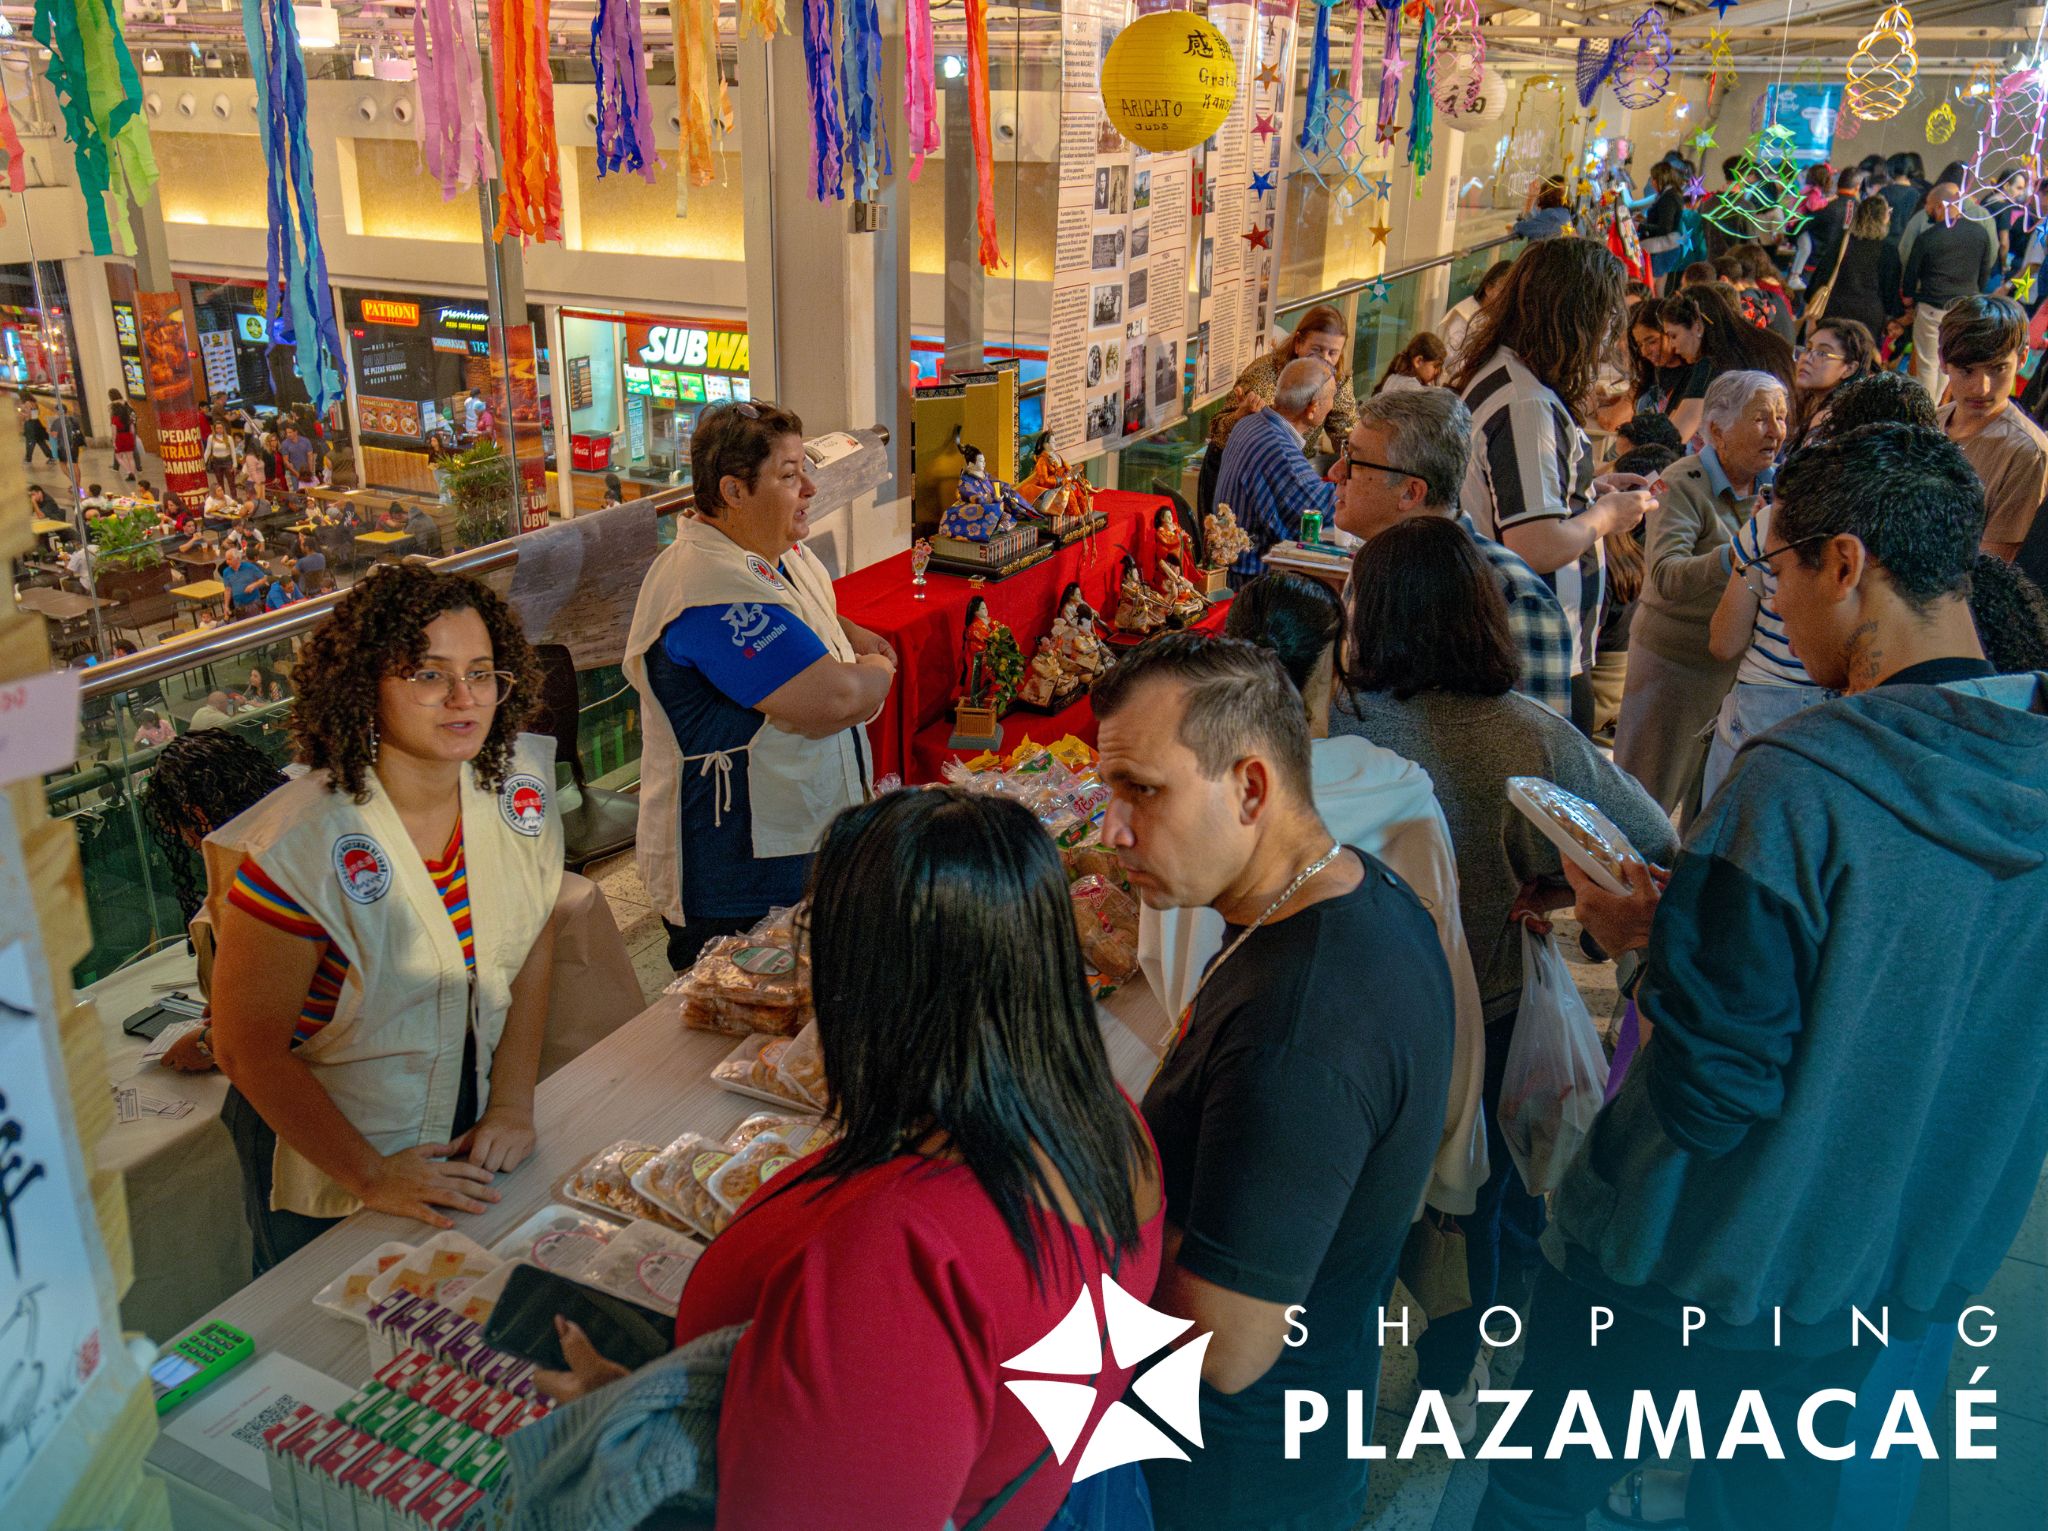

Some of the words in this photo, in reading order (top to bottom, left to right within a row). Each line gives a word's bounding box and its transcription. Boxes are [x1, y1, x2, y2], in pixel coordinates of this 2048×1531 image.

[364, 301, 416, 320] PATRONI
[440, 309, 489, 323] premium
[639, 325, 749, 371] SUBWA
[752, 623, 788, 652] Shinobu
